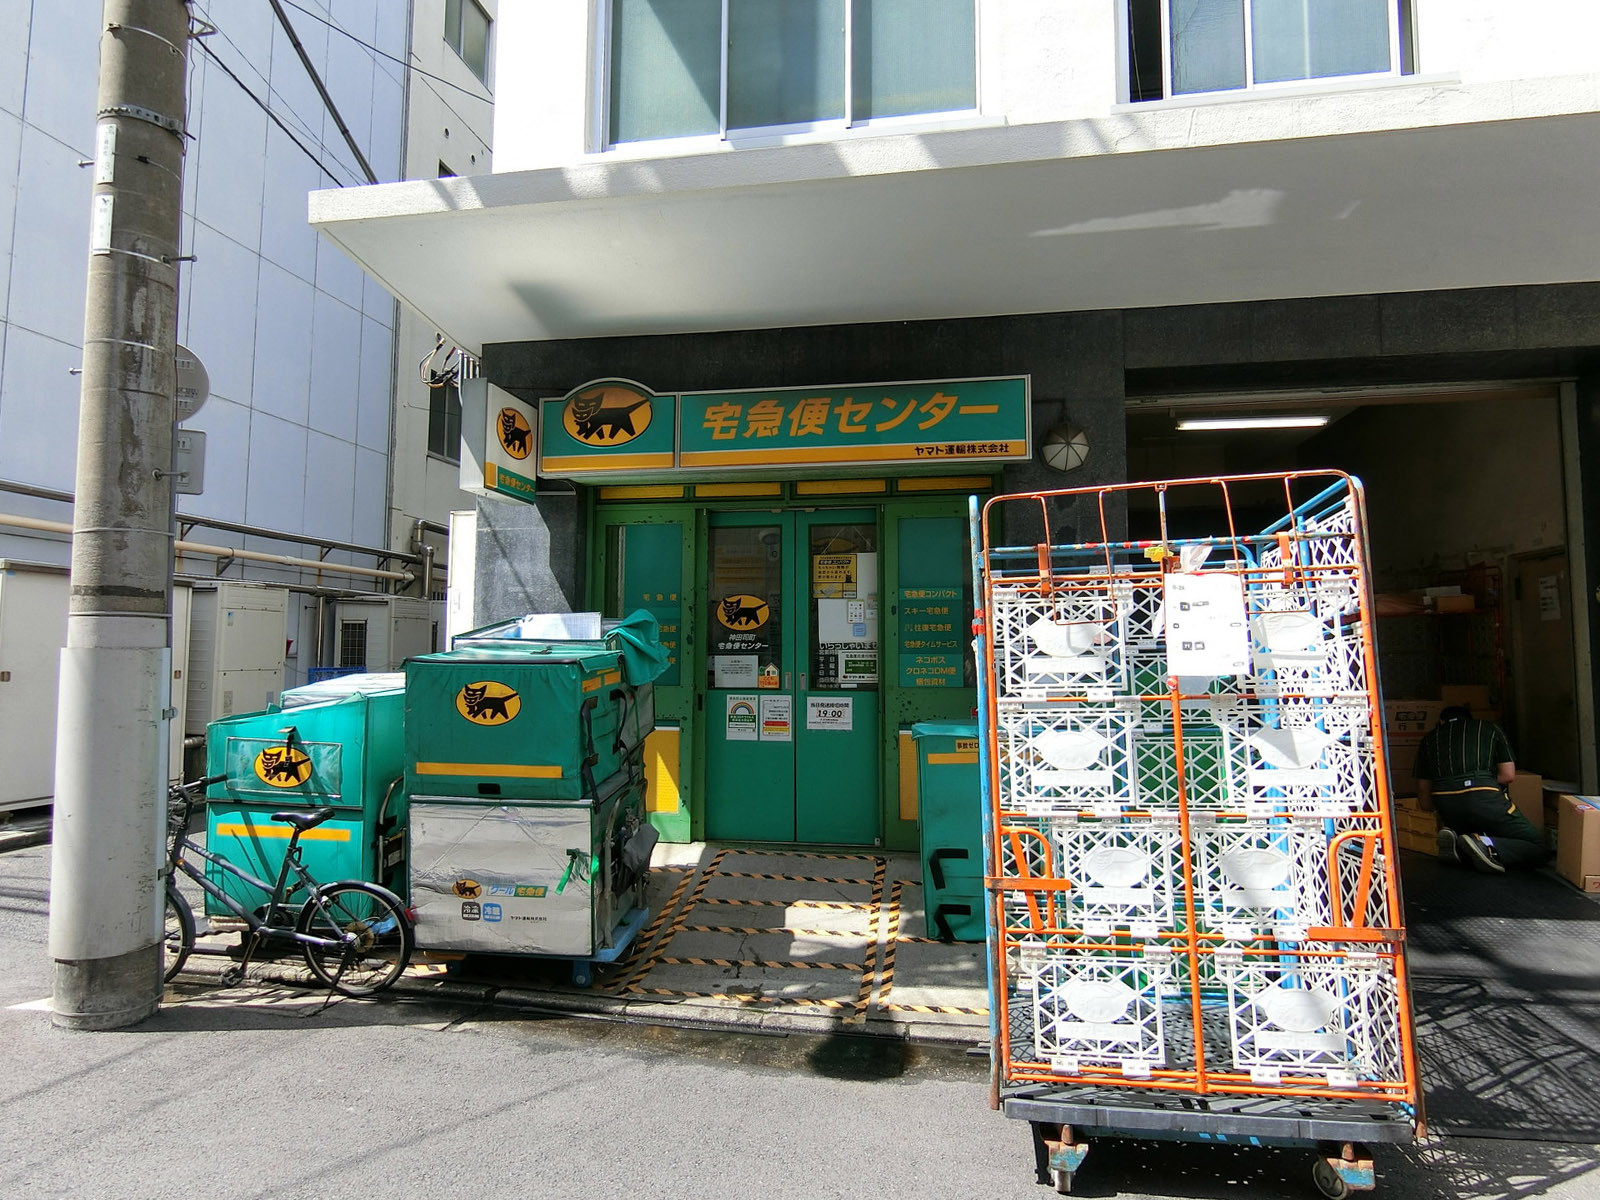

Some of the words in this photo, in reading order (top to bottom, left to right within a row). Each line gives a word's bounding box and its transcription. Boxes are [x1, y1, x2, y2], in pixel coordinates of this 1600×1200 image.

[703, 391, 999, 441] 宅急便センター
[915, 442, 1010, 456] ヤマト運輸株式会社
[499, 472, 535, 494] 宅急便センター
[904, 590, 958, 599] 宅急便コンパクト
[904, 607, 949, 615] スキー宅急便
[728, 633, 757, 642] 神田司町
[718, 642, 769, 650] 宅急便センター
[904, 640, 958, 649] 宅急便タイムサービス
[905, 667, 957, 676] クロネコDM便
[818, 709, 843, 718] 19:00
[490, 886, 544, 896] クール宅急便
